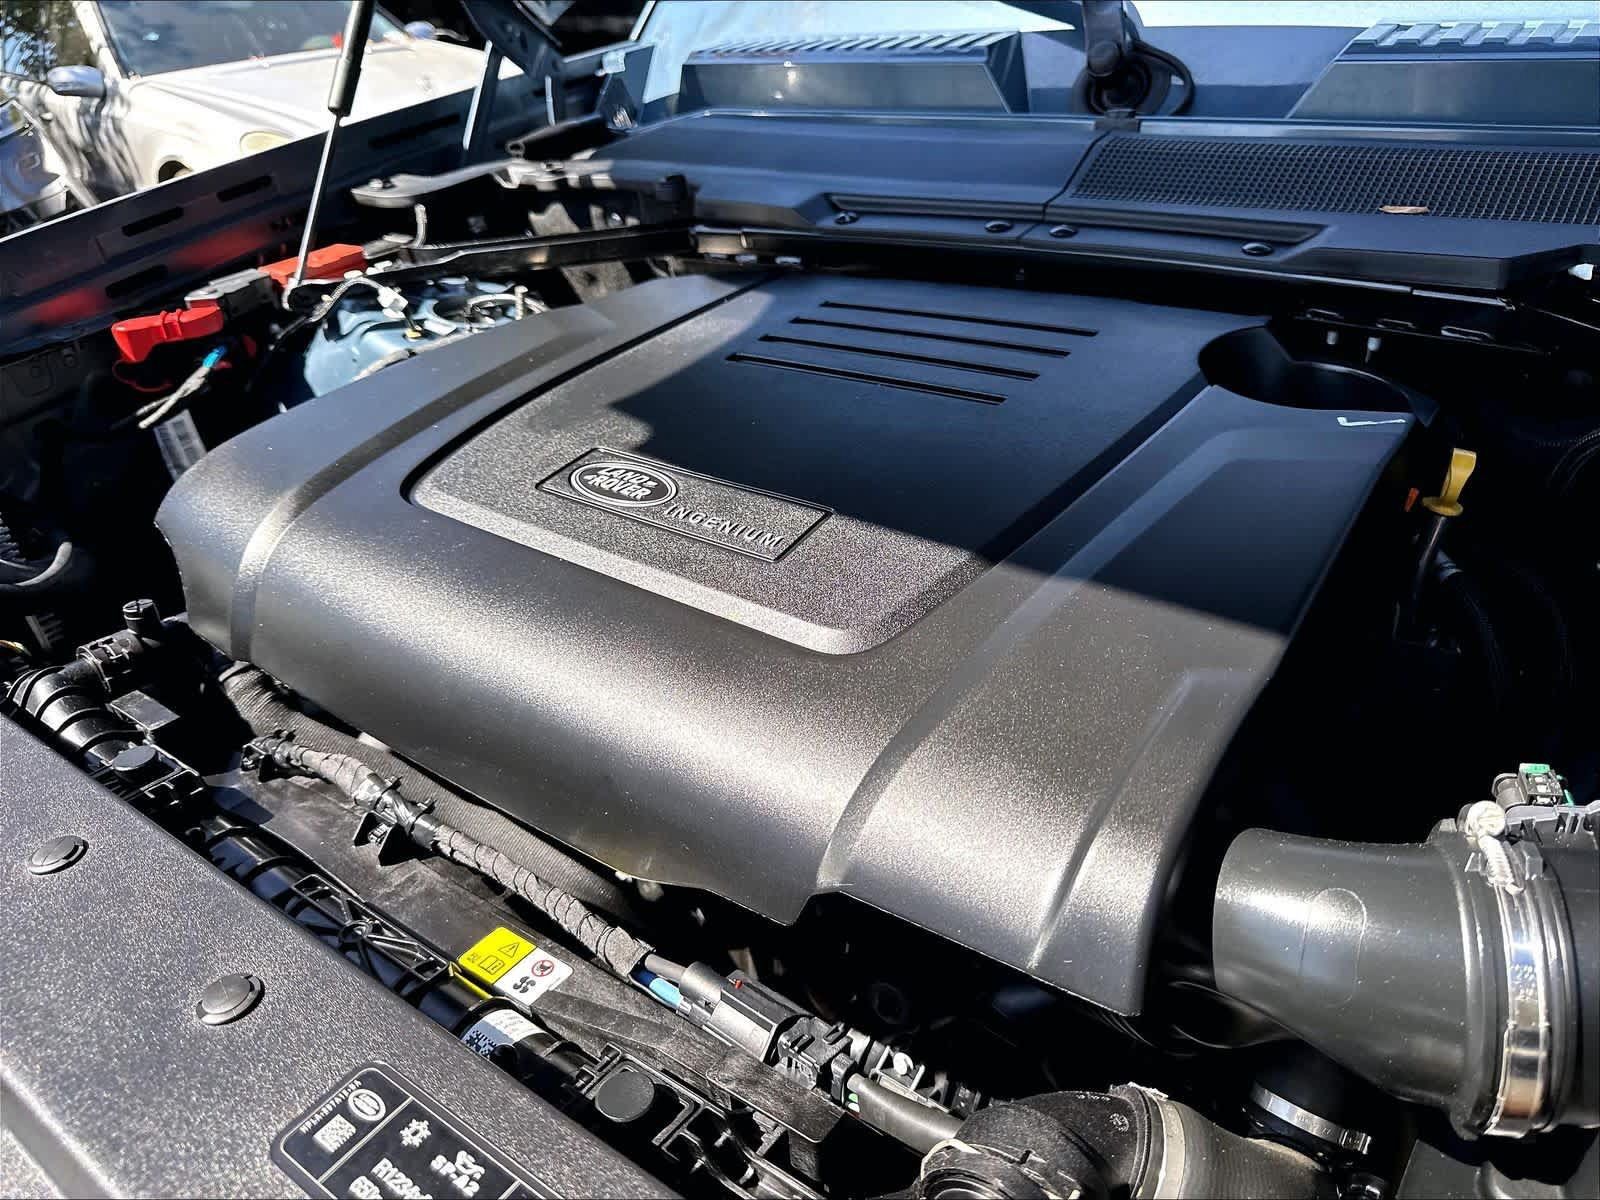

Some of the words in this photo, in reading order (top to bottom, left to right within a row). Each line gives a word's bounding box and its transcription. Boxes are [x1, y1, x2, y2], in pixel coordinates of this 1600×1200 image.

[587, 475, 652, 500] ROVER
[597, 467, 650, 485] LAND
[663, 502, 785, 548] INGENIUM
[430, 1154, 480, 1198] SP-A2
